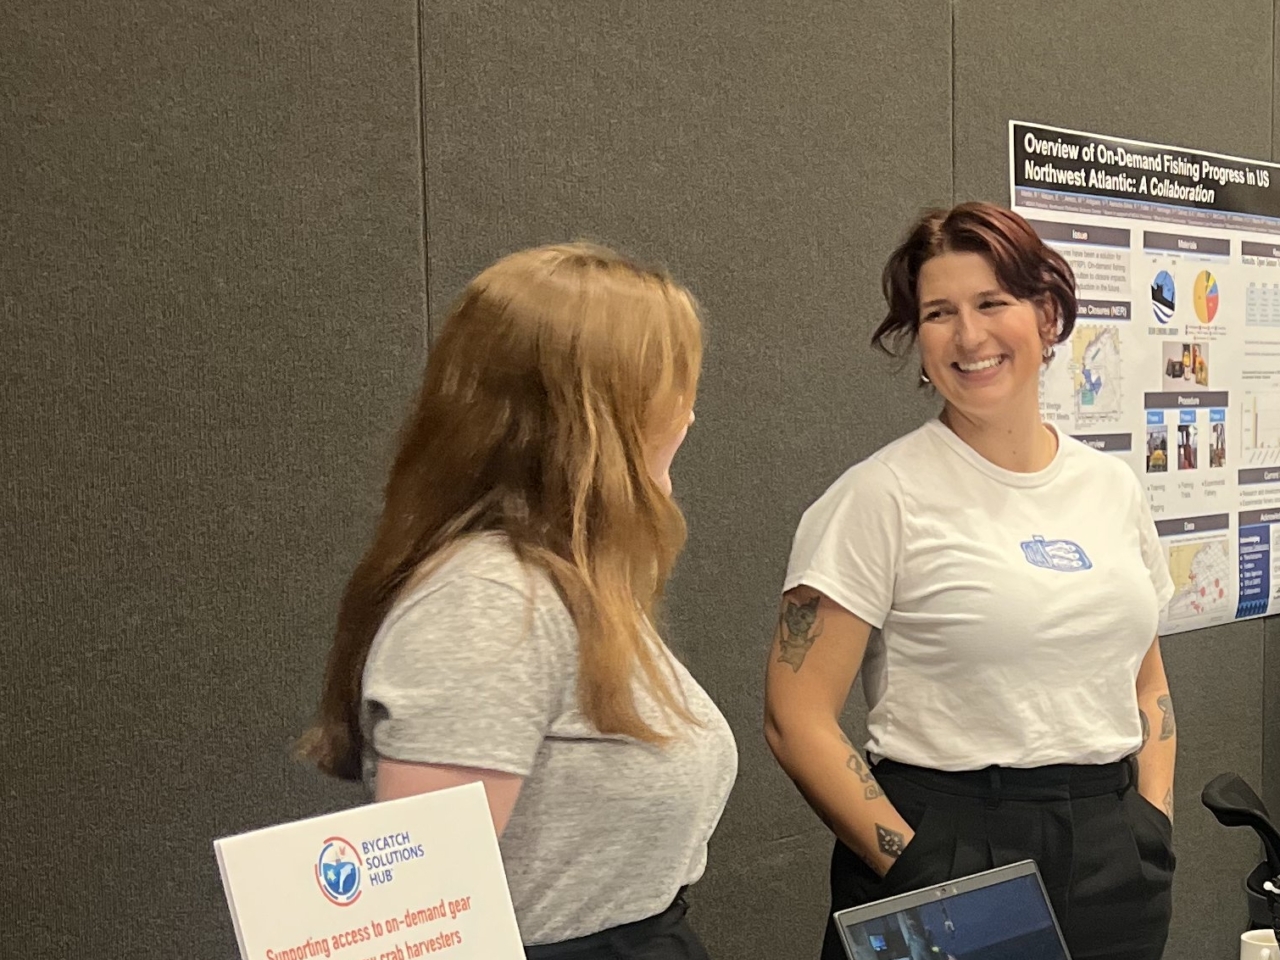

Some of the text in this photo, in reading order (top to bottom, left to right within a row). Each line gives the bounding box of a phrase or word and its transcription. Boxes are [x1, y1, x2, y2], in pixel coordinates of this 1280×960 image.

[1024, 133, 1269, 188] Overview of On-Demand Fishing Progress in US
[1024, 160, 1215, 203] Northwest Atlantic: A Collaboration
[1072, 229, 1088, 240] Issue
[1088, 305, 1110, 315] Closures
[1178, 395, 1200, 405] Procedure
[362, 831, 410, 855] BYCATCH
[366, 844, 424, 870] SOLUTIONS
[369, 869, 393, 886] HUB
[331, 926, 371, 950] access
[371, 920, 383, 937] to
[384, 899, 446, 934] on-demand
[448, 896, 471, 919] gear
[405, 930, 462, 960] harvesters
